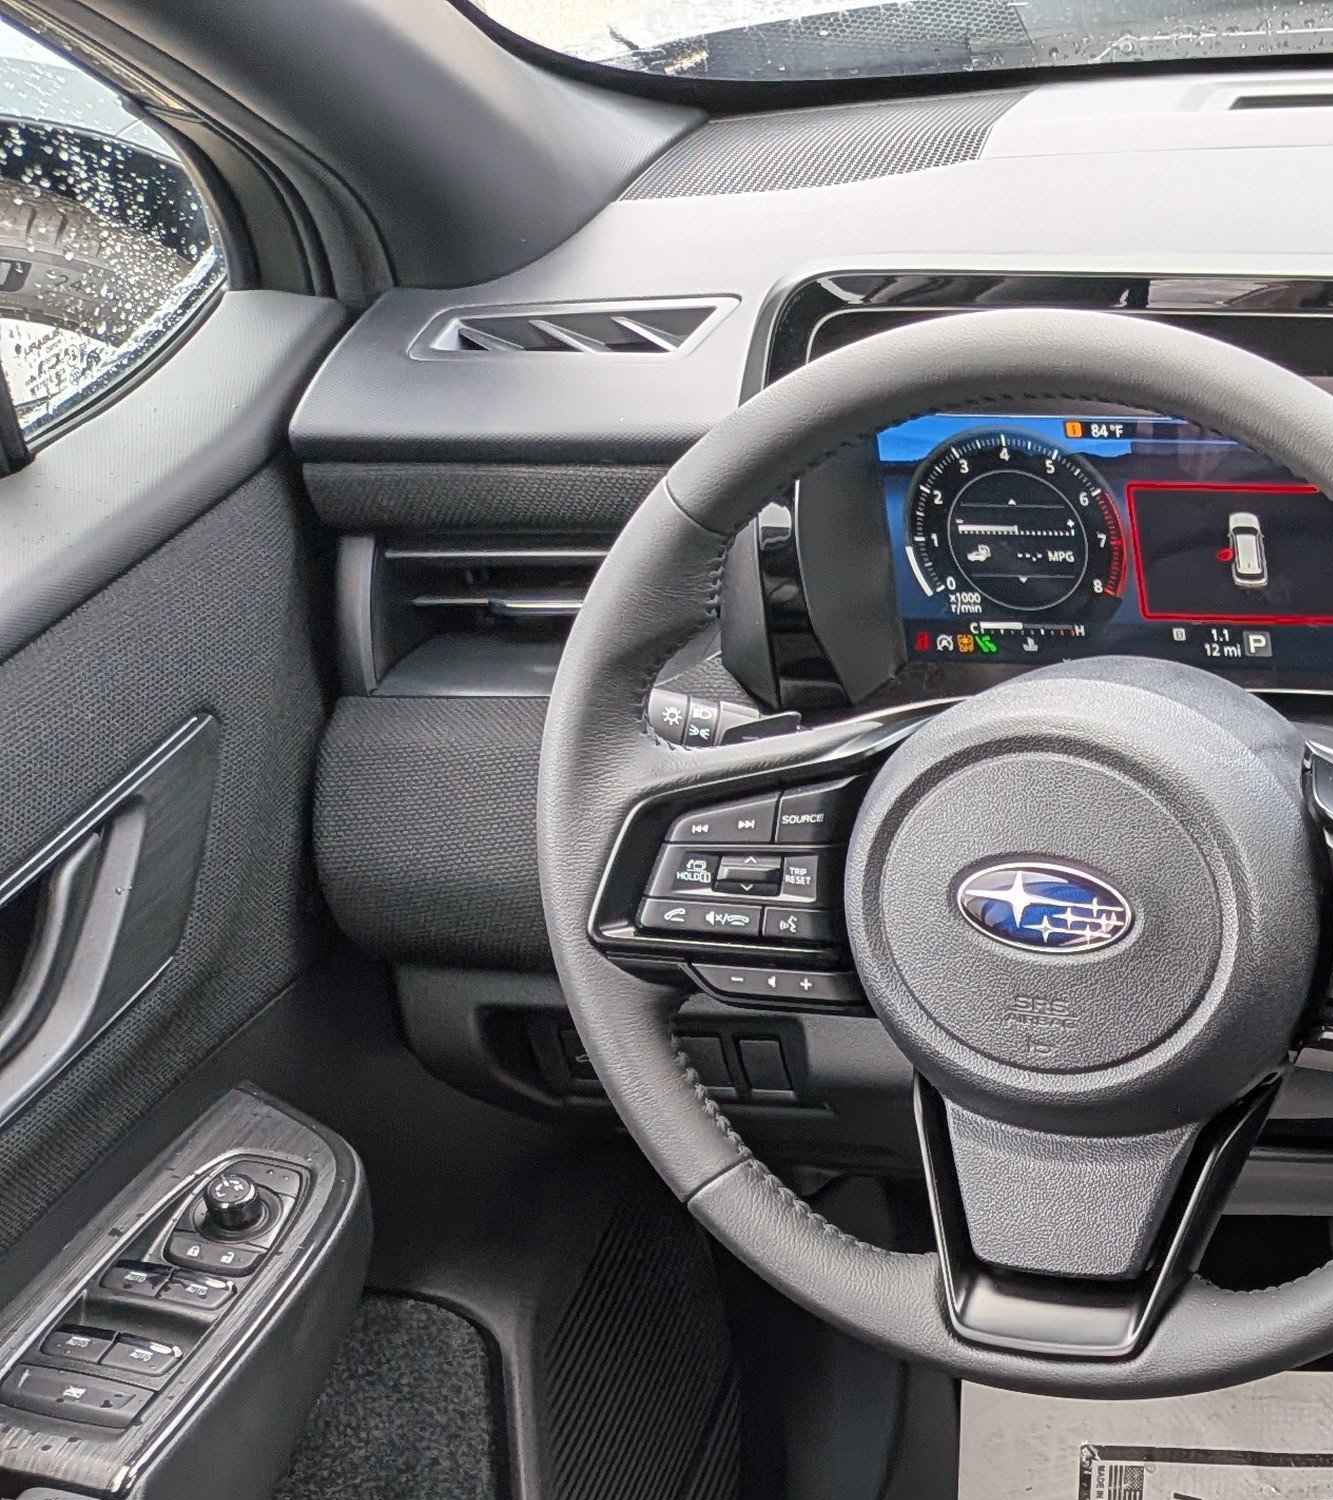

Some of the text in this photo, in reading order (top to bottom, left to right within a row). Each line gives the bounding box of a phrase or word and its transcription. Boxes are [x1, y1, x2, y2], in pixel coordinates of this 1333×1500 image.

[1048, 550, 1075, 563] MPG
[951, 602, 982, 615] r/min
[1211, 628, 1229, 642] 1.1
[1204, 642, 1241, 658] 12 mi
[1249, 634, 1266, 654] P
[1096, 1465, 1106, 1489] MADE
